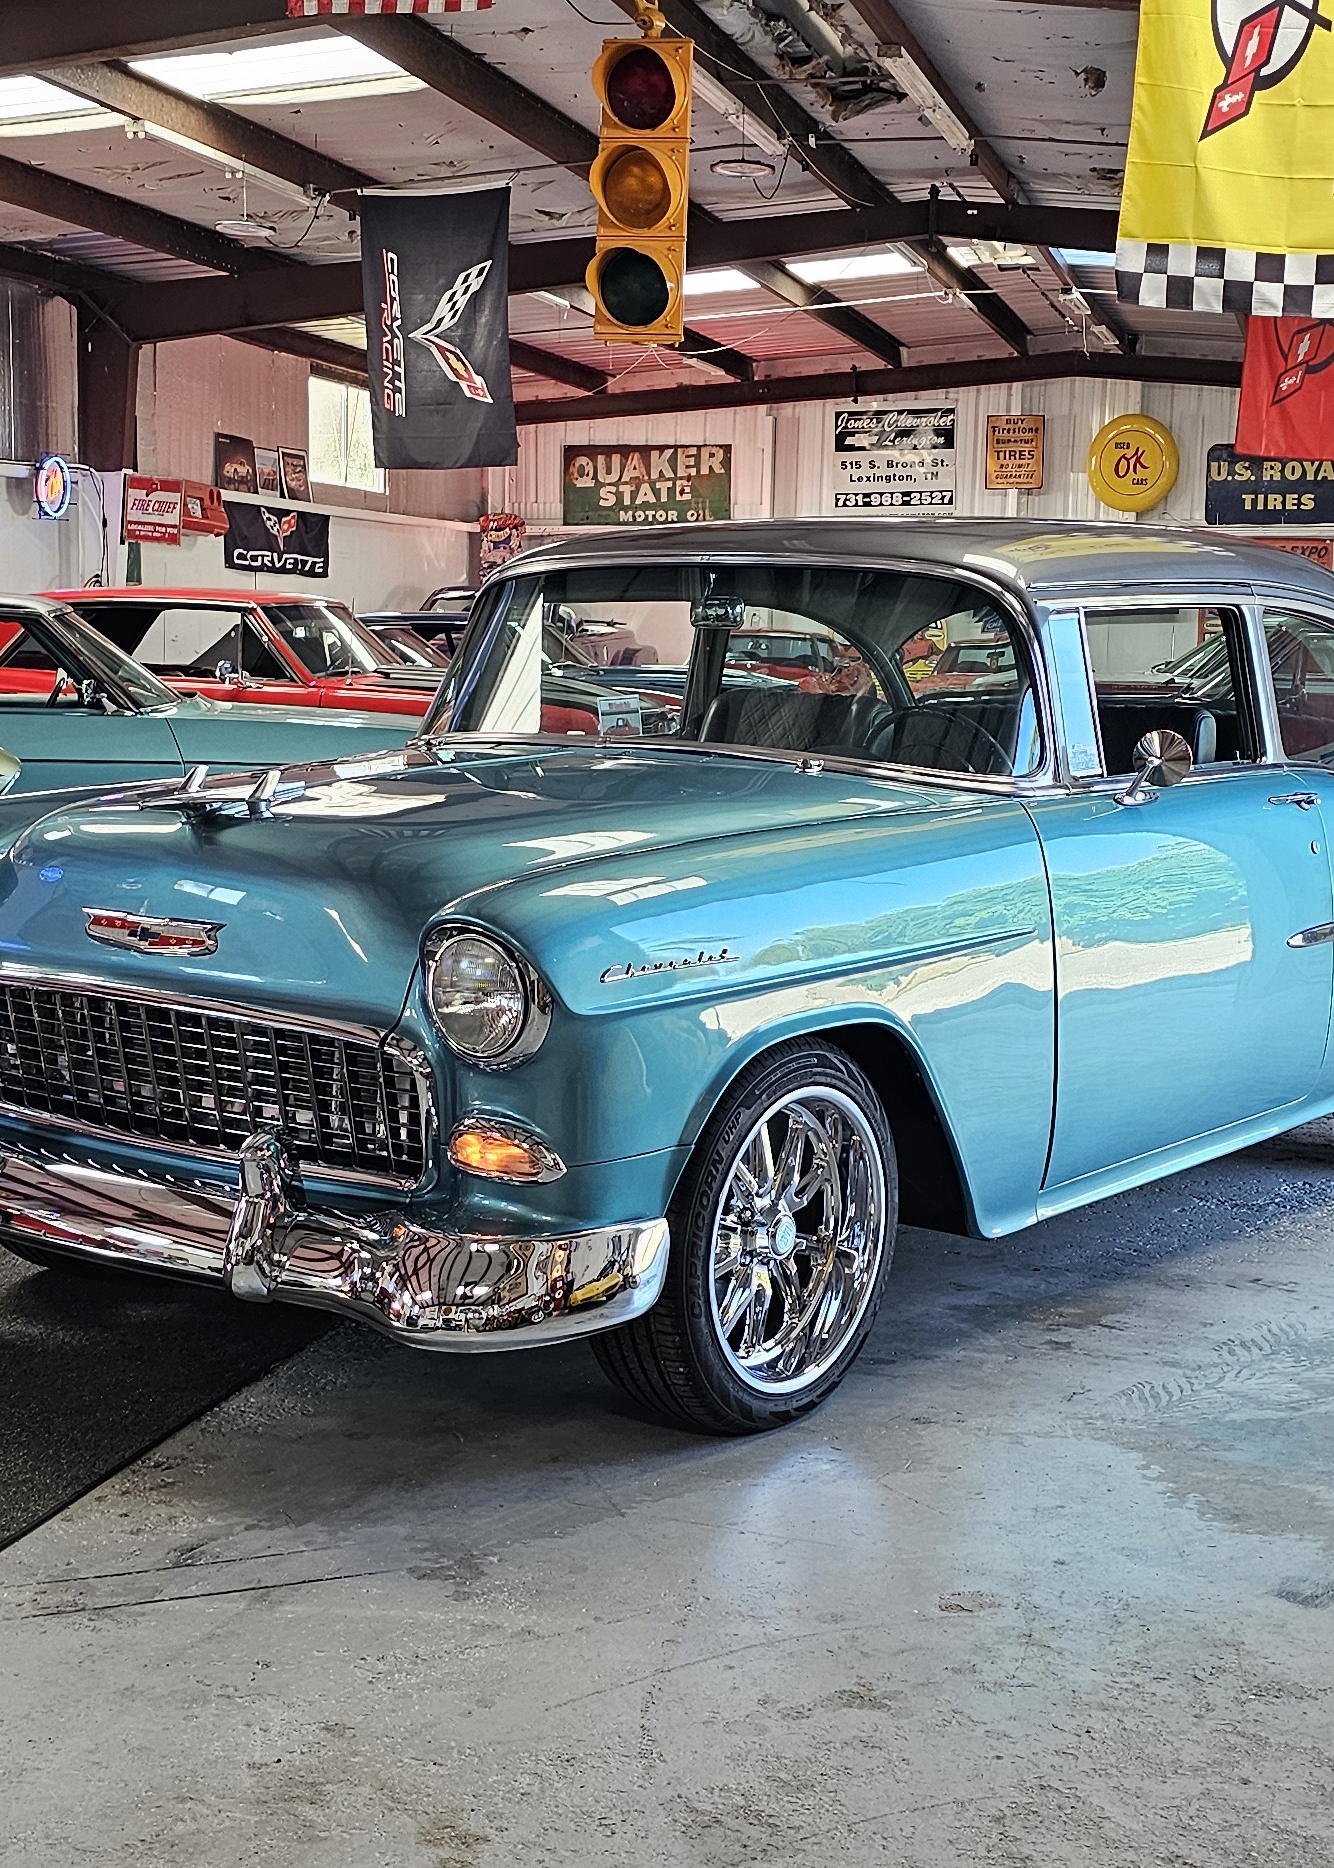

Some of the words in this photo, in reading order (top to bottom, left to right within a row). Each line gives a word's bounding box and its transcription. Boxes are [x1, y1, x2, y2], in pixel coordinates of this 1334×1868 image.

[387, 251, 406, 417] CORVETTE
[381, 302, 394, 412] RACING
[835, 413, 877, 434] Jones
[884, 411, 955, 431] Chevrolet
[991, 426, 1040, 435] Firestone
[882, 432, 945, 448] Lexington
[840, 461, 862, 470] 515
[868, 460, 881, 469] S.
[886, 459, 925, 468] Broad
[931, 458, 949, 467] St.
[994, 450, 1035, 460] TIRES
[1114, 446, 1150, 479] OK
[569, 446, 725, 487] QUAKER
[1210, 461, 1255, 481] U.S.
[849, 473, 917, 483] Lexington,
[923, 472, 939, 481] TN
[598, 480, 692, 507] STATE
[836, 491, 952, 506] 731-968-2527
[1242, 494, 1315, 510] TIRES
[130, 498, 152, 511] FIRE
[152, 500, 178, 513] CHIEF
[619, 510, 678, 522] MOTOR
[686, 510, 714, 522] OIL
[233, 549, 324, 572] CORVETTE
[1290, 545, 1329, 559] EXPO
[599, 949, 740, 983] Chevrolet
[689, 1152, 725, 1319] CAPRICORN
[722, 1109, 742, 1146] UHP
